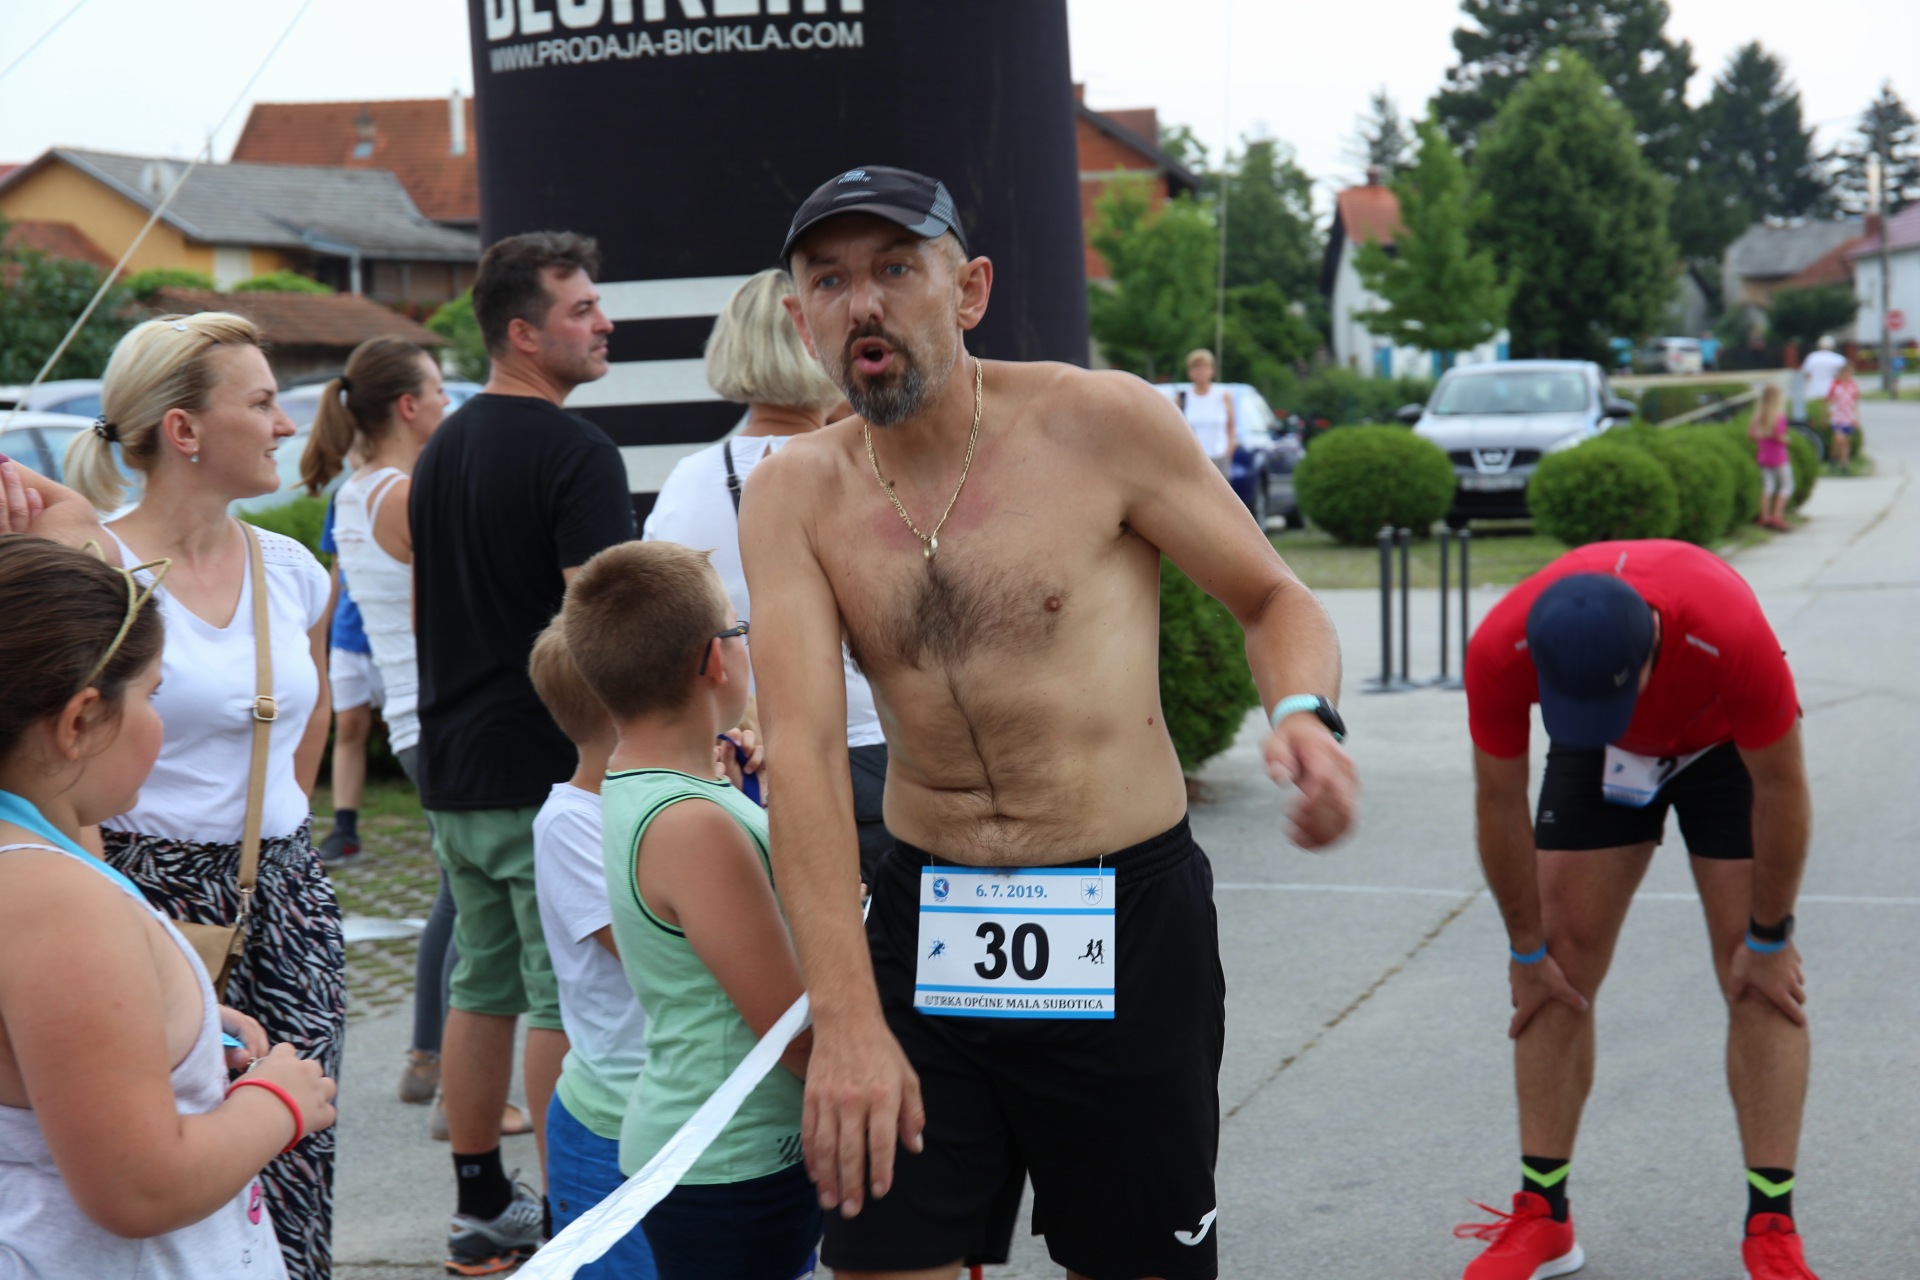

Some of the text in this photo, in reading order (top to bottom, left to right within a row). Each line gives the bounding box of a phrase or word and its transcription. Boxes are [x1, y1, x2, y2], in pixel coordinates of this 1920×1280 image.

[489, 21, 864, 73] WWW.PRODAJA-BICIKLA.COM
[975, 884, 1048, 899] 6. 7. 2019.
[974, 921, 1050, 981] 30
[924, 994, 1104, 1010] UTRKA OPĆINE MALA SUBOTICA
